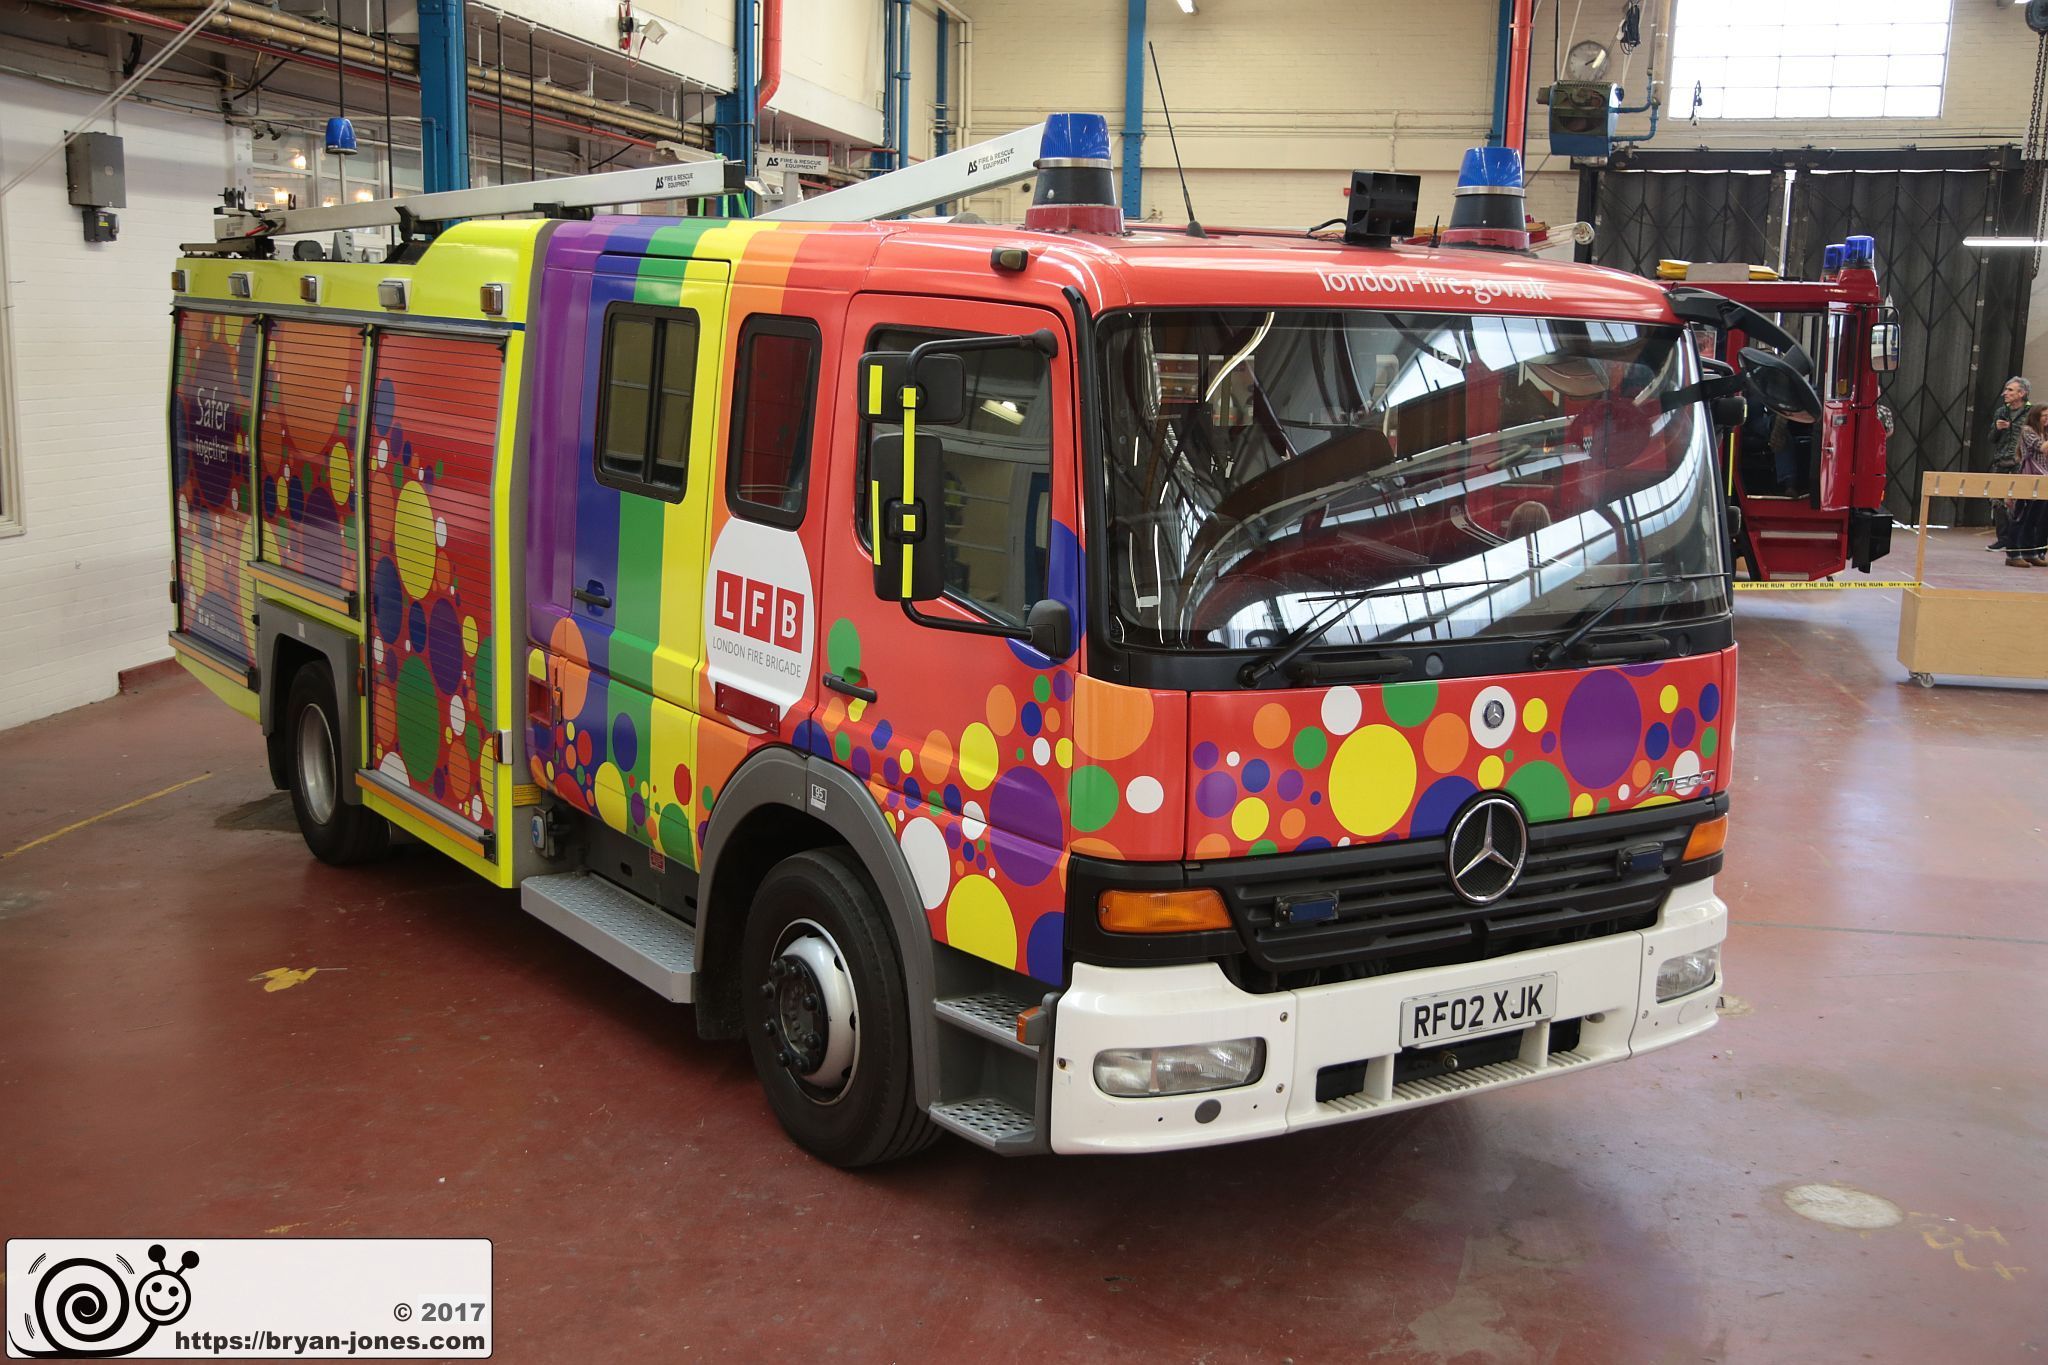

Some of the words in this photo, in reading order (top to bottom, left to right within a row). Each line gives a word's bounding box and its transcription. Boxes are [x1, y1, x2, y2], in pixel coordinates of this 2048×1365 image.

[766, 156, 779, 167] AS
[967, 160, 978, 176] AS
[994, 147, 1015, 160] RESCUE
[982, 156, 1011, 170] EQUIPMENT
[655, 177, 664, 190] AS
[677, 173, 694, 181] RESCUE
[668, 180, 690, 189] EQUIPMENT
[1314, 267, 1552, 305] london-fire.gov.uk
[195, 386, 230, 432] Safer
[195, 434, 229, 466] together
[721, 581, 798, 640] LFB
[712, 636, 746, 659] LONDON
[747, 648, 764, 665] FIRE
[765, 654, 801, 678] BRIGADE
[1413, 995, 1485, 1039] RF02
[1492, 983, 1544, 1024] XJK
